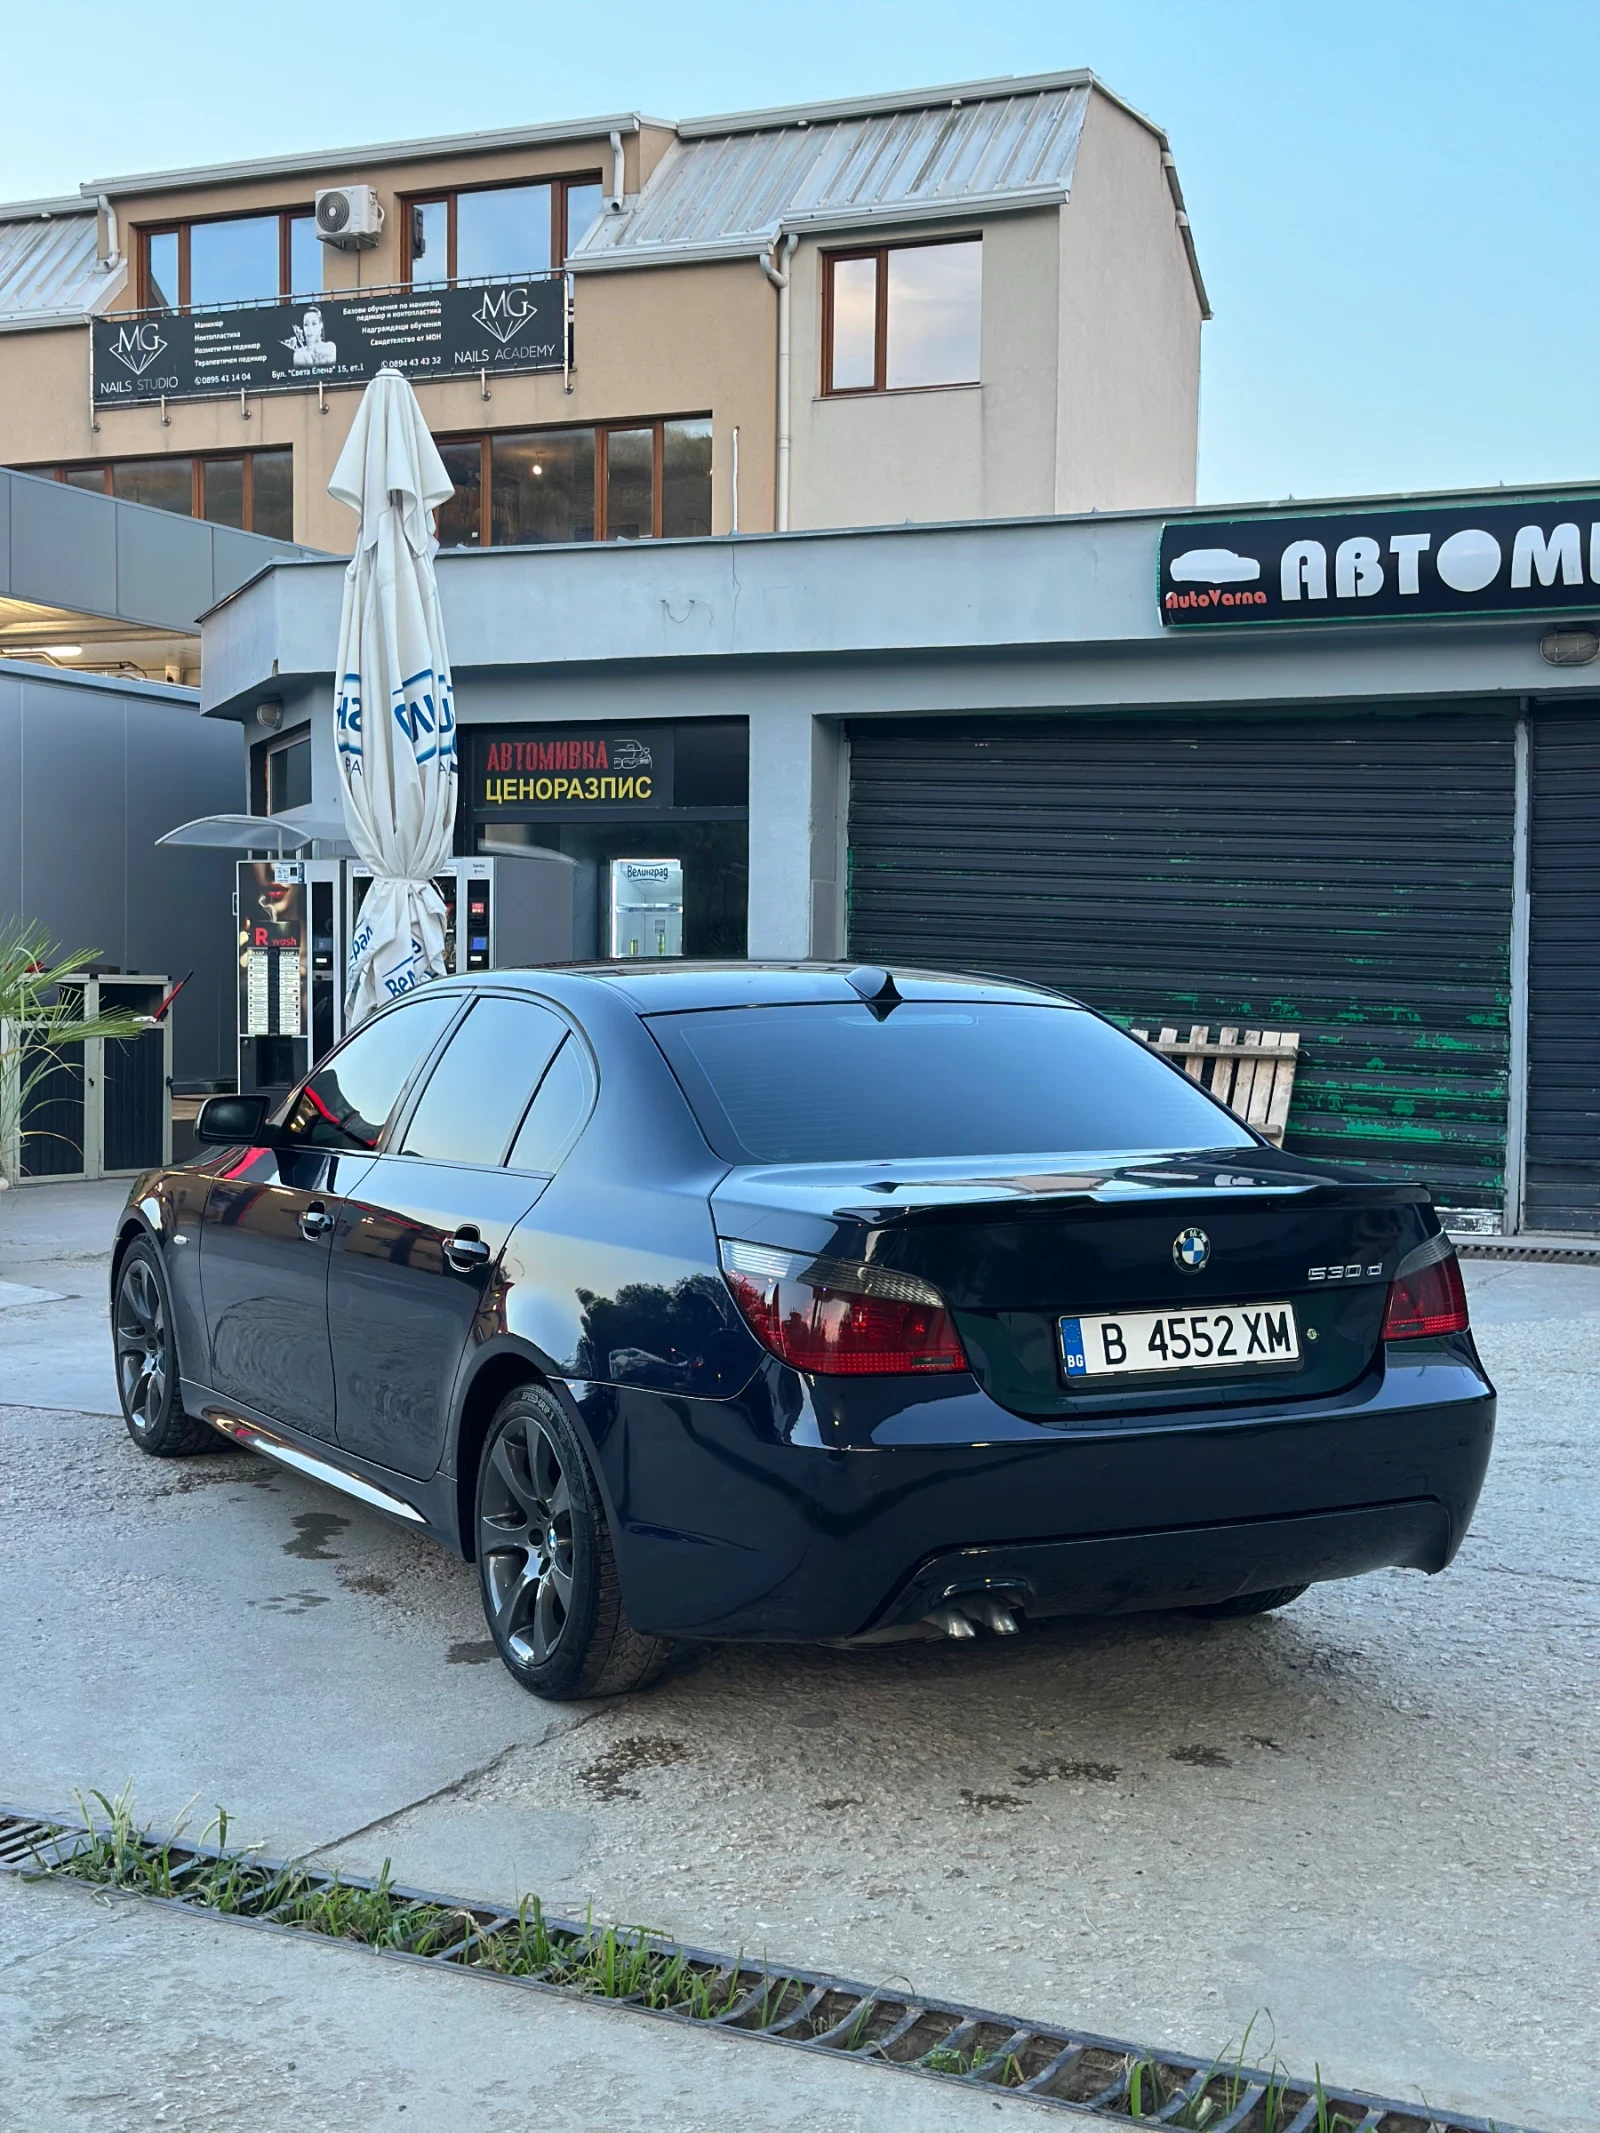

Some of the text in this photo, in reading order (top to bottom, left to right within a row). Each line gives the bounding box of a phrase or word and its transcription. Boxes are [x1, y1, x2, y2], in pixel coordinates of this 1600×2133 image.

[481, 288, 528, 320] MG
[194, 321, 224, 329] Маникюр
[118, 323, 159, 353] MG
[194, 332, 241, 341] Ноктопластика
[425, 333, 442, 341] МОН
[389, 356, 442, 368] 0894 43 43 32
[455, 344, 556, 364] NAILS ACADEMY
[101, 376, 179, 394] NAILS STUDIO
[202, 372, 252, 385] 0895 41 14 04
[1281, 522, 1600, 601] АВТОМ
[1165, 588, 1267, 609] AutoVarna
[486, 740, 609, 772] АВТОМИВКА
[486, 776, 652, 805] ЦЕНОРАЗПИС
[627, 865, 668, 879] Велинград
[255, 927, 297, 946] R wash
[1308, 1265, 1361, 1280] 530
[1101, 1311, 1291, 1365] B 4552 XM
[1067, 1355, 1084, 1368] BG
